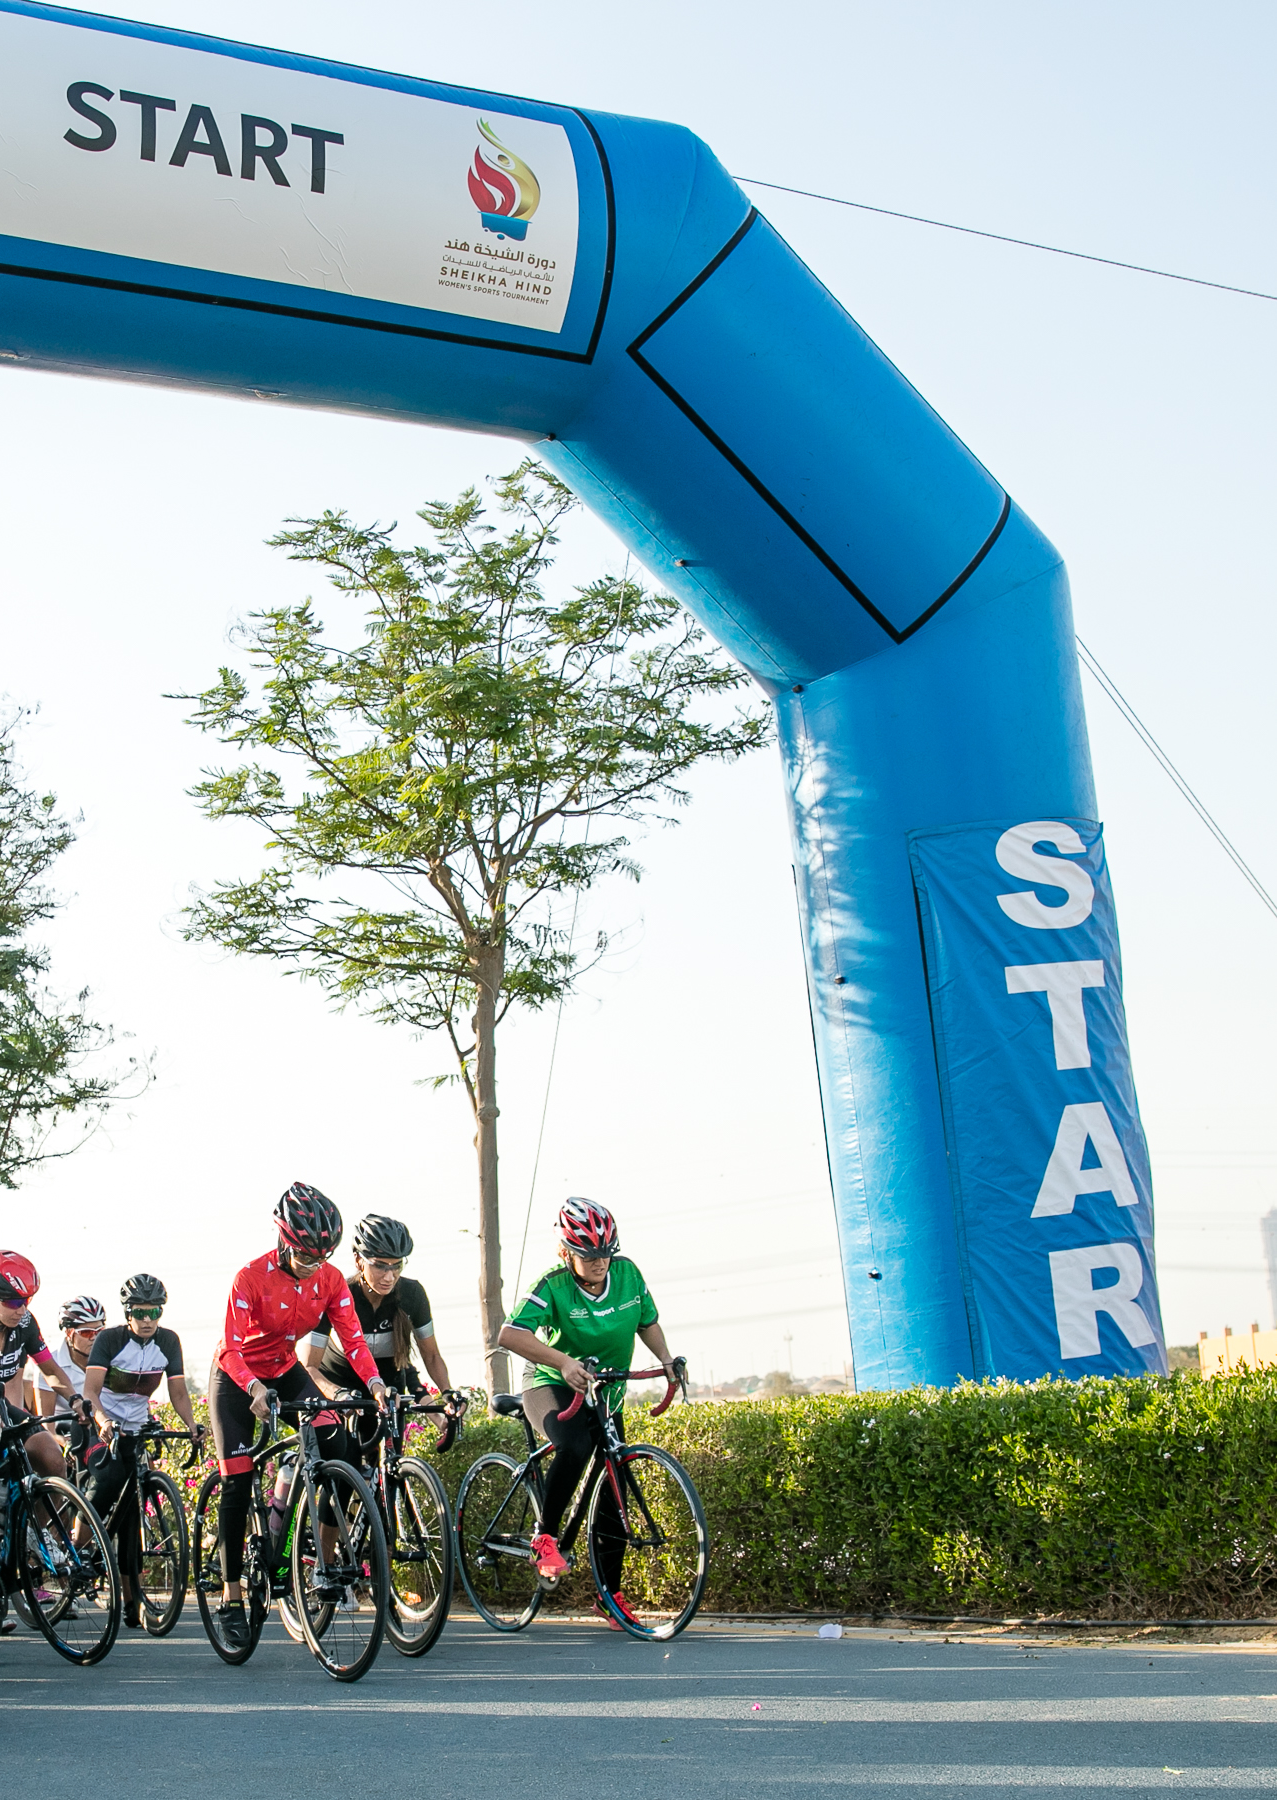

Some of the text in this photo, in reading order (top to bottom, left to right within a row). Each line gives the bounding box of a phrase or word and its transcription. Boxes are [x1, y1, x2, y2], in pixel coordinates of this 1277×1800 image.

[63, 80, 345, 195] START
[444, 238, 556, 270] دورة الشيخة هند
[437, 278, 549, 306] WOMEN'S SPORTS TOURNAMENT
[440, 265, 552, 296] SHEIKHA HIND
[5, 1272, 22, 1291] MET
